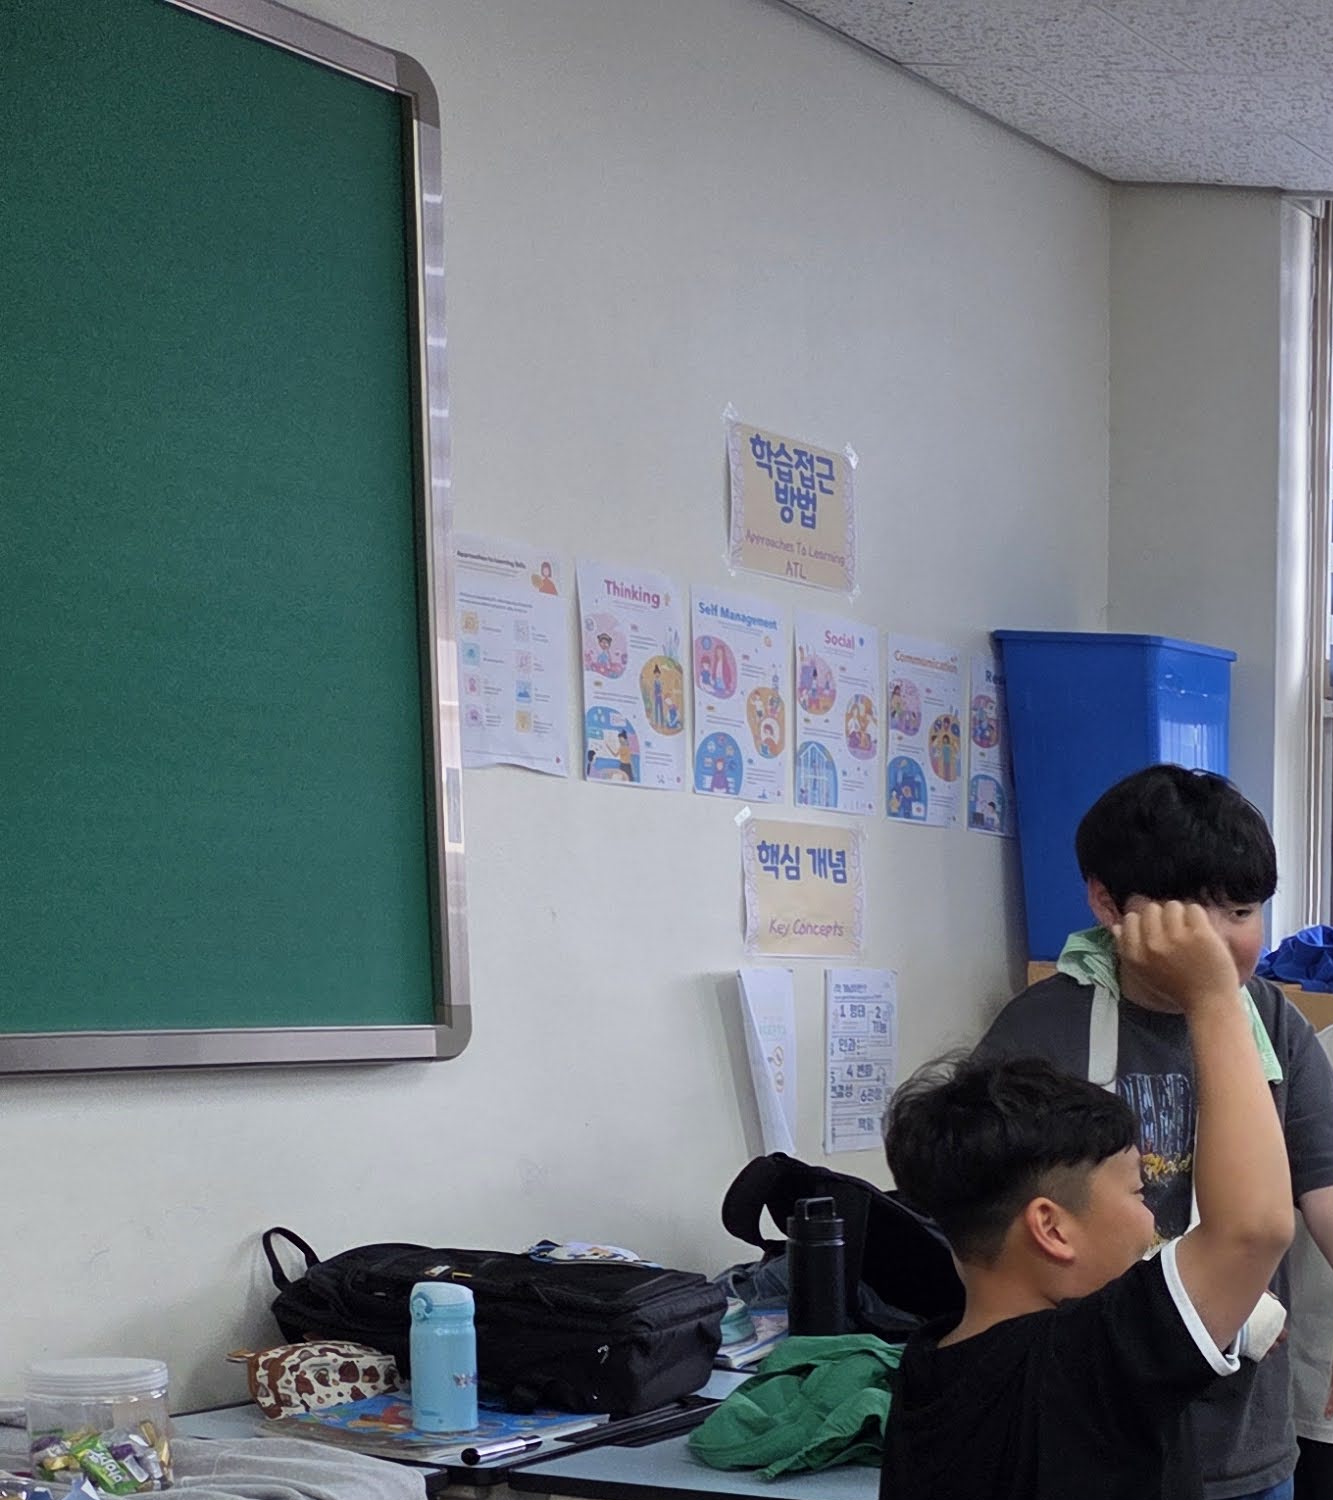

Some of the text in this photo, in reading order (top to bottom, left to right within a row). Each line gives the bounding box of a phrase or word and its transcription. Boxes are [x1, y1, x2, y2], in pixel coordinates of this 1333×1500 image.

[750, 433, 836, 495] 학습접근
[775, 481, 817, 530] 방법
[744, 528, 795, 553] Approaches
[808, 548, 846, 567] Learning
[785, 561, 808, 580] ATL
[604, 578, 662, 609] Thinking
[698, 601, 778, 632] Self Management
[824, 629, 856, 650] Social
[757, 839, 849, 885] 핵심 개념
[769, 917, 845, 939] Key Concepts
